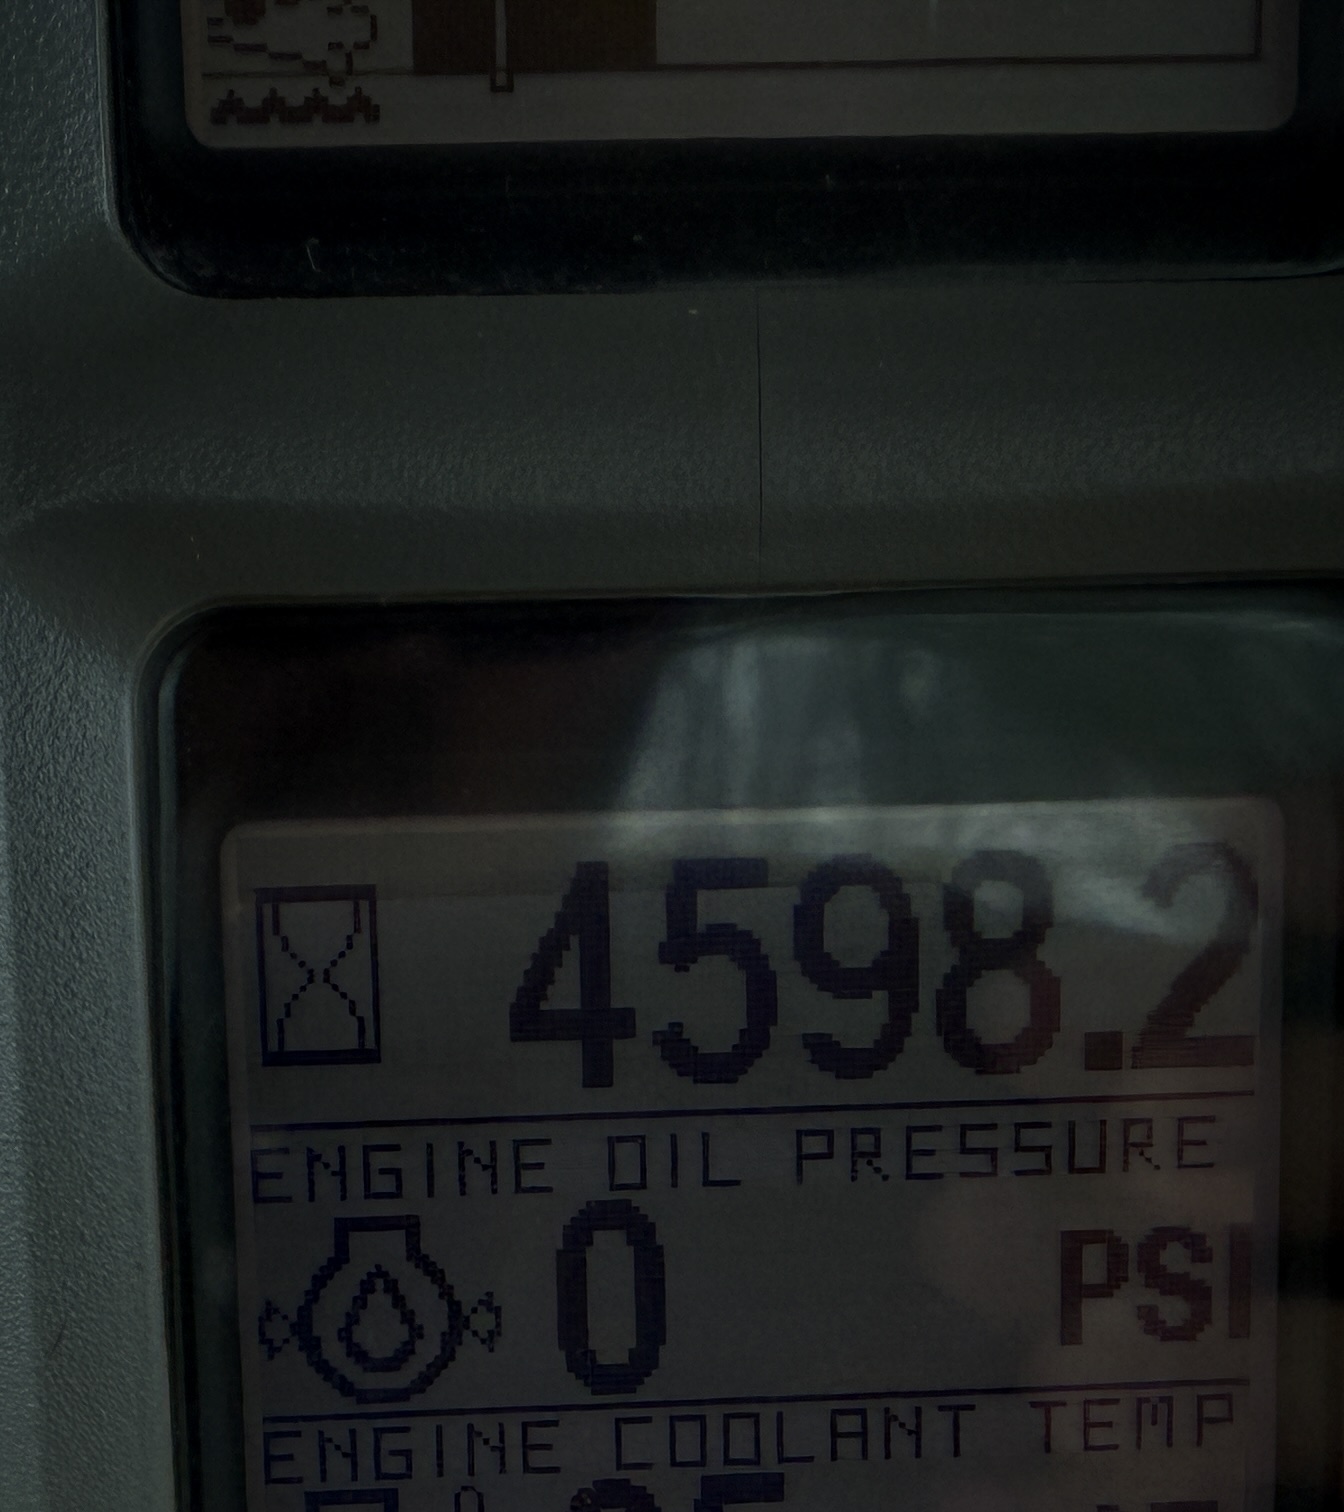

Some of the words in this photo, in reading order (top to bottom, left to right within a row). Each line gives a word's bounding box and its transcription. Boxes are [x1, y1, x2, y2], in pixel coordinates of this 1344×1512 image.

[509, 842, 1254, 1088] 4598.2
[250, 1137, 555, 1202] ENGINE
[607, 1131, 742, 1191] OIL
[795, 1115, 1216, 1185] PRESSURE
[556, 1200, 666, 1395] 0
[1059, 1222, 1251, 1345] PSI
[263, 1419, 562, 1484] ENGINE
[614, 1404, 974, 1471] COOLANT
[1030, 1394, 1234, 1454] TEMP
